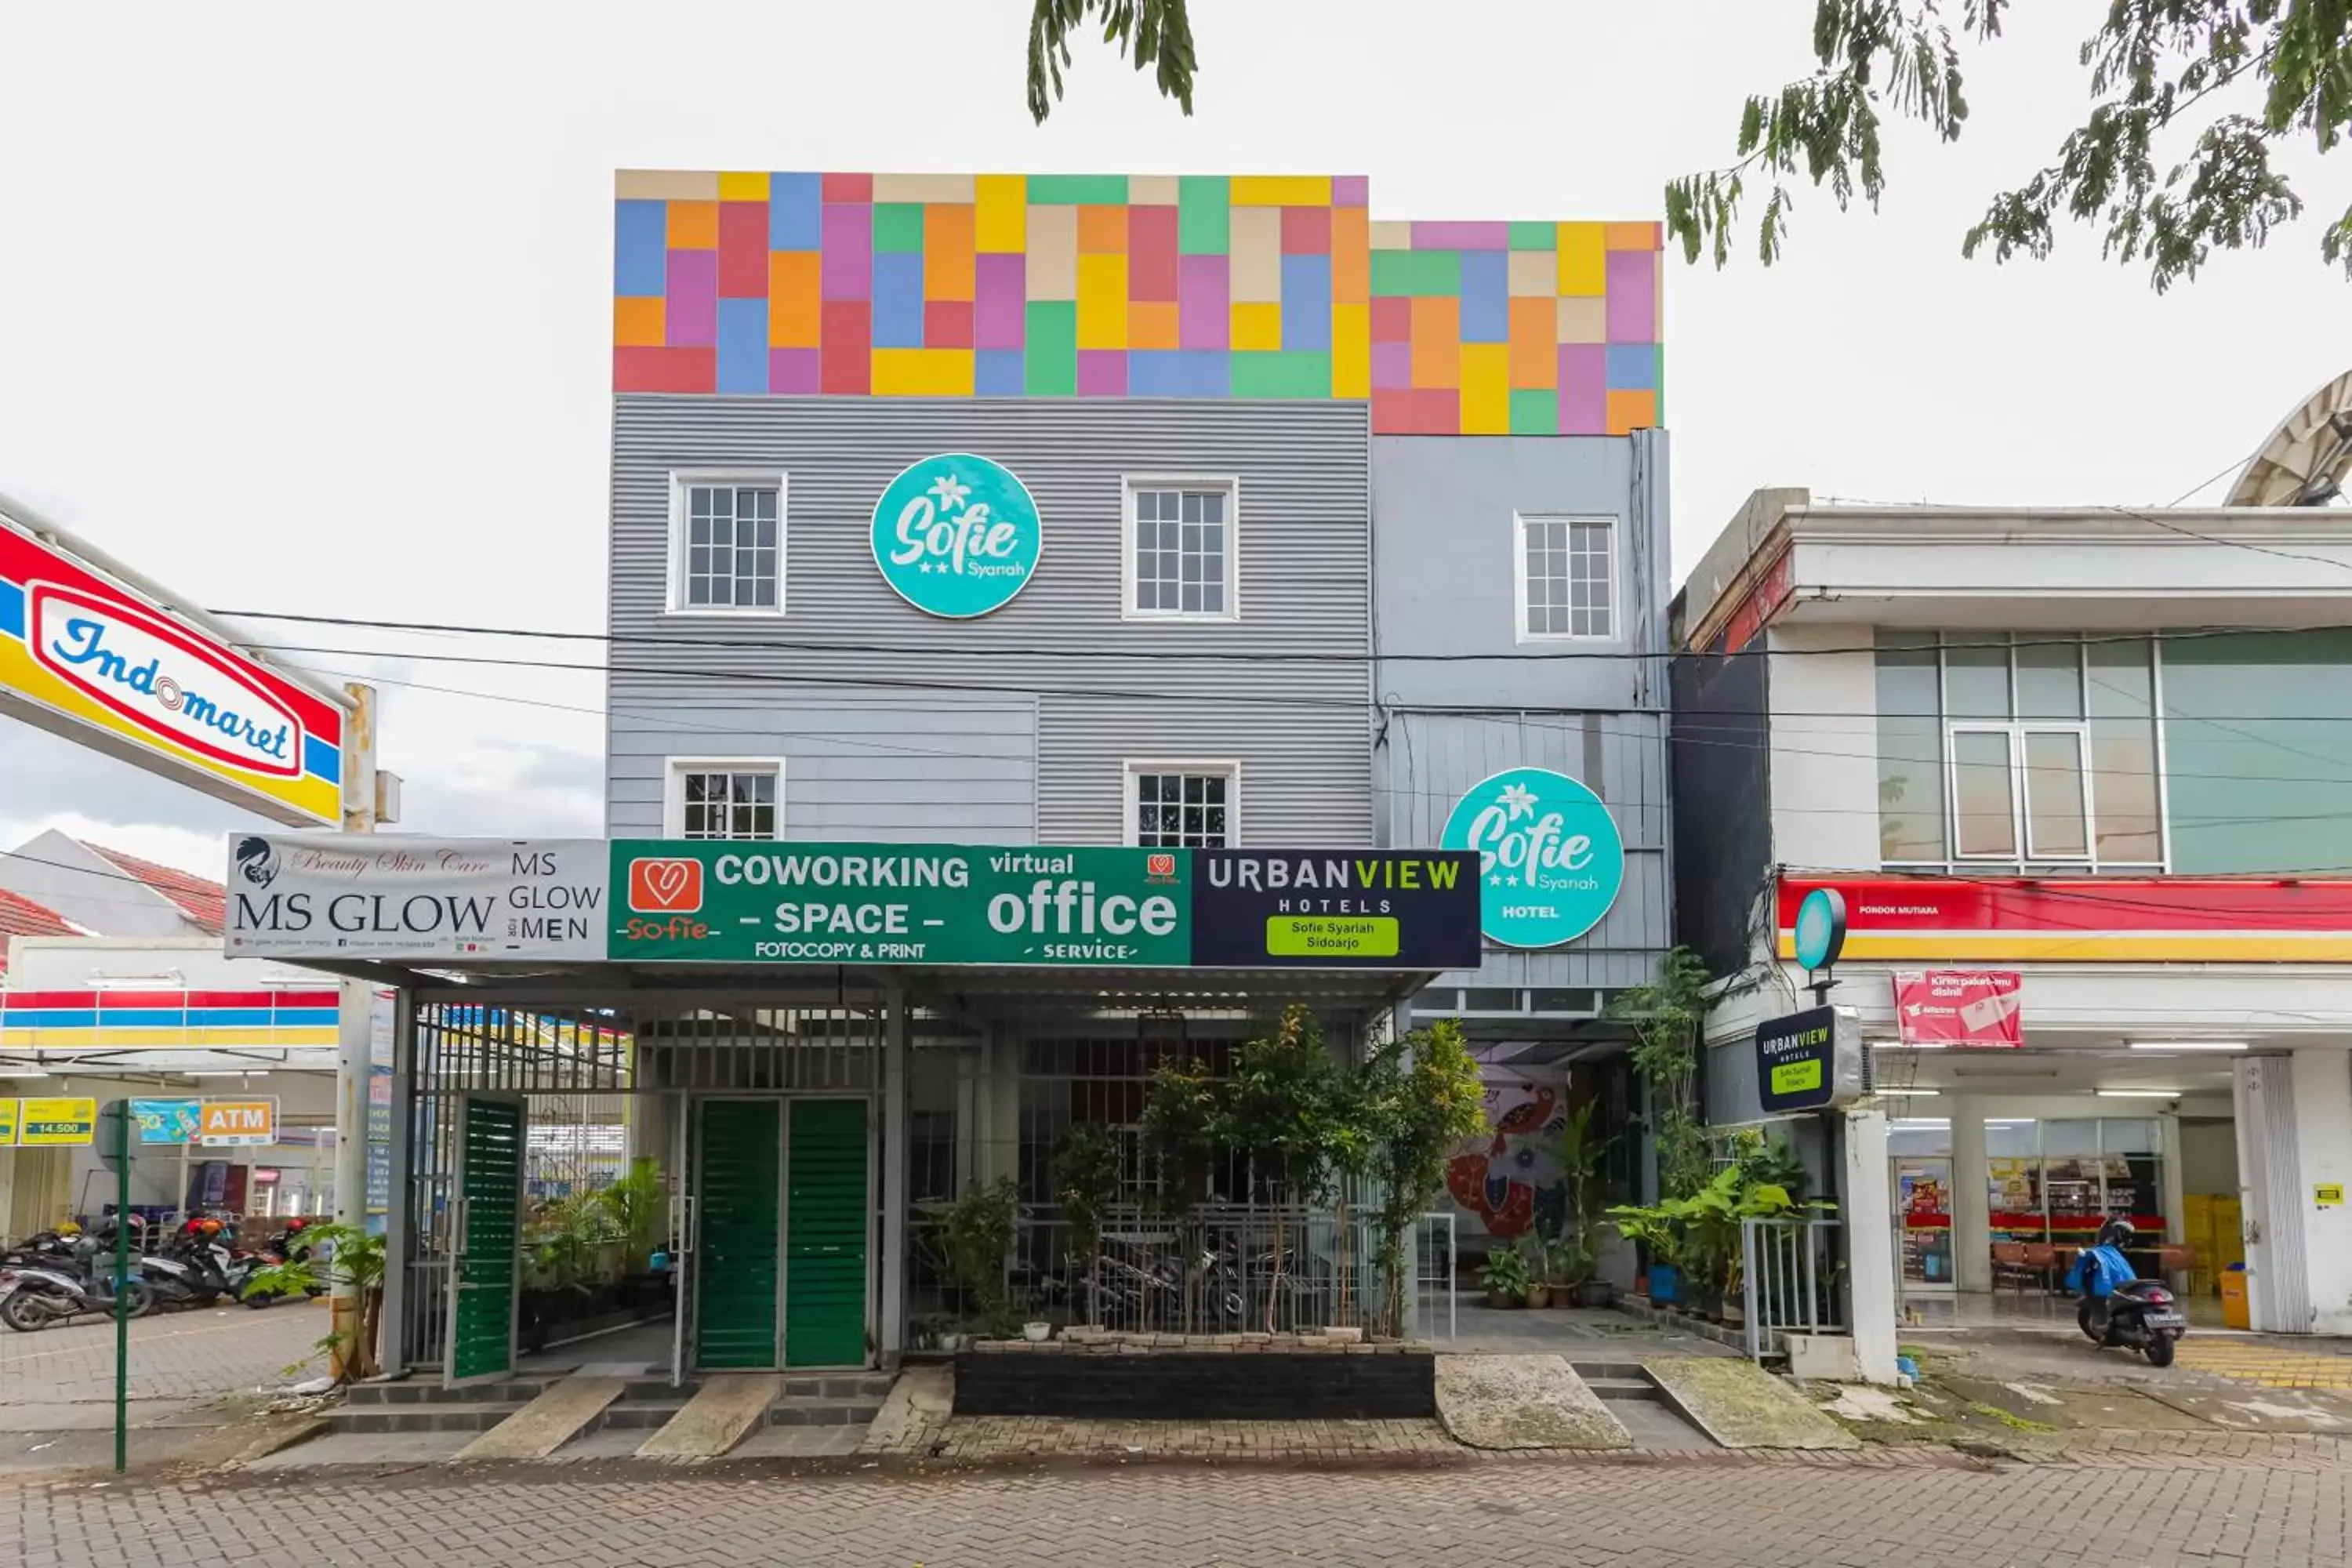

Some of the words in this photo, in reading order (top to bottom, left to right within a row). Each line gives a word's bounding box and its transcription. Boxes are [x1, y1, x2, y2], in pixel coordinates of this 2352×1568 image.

[891, 495, 1018, 575] Sofie
[967, 561, 1025, 579] Syariah
[53, 618, 287, 760] Indomaret
[1468, 806, 1594, 887] Sofie
[292, 848, 368, 879] Beauty
[376, 851, 426, 873] Skin
[436, 848, 489, 875] Care
[512, 852, 556, 876] MS
[714, 854, 969, 888] COWORKING
[989, 852, 1073, 874] virtual
[1208, 858, 1459, 892] URBANVIEW
[1539, 874, 1599, 891] Syariah
[509, 885, 601, 909] GLOW
[987, 879, 1176, 936] office
[1279, 898, 1391, 913] HOTELS
[233, 893, 312, 931] MS
[328, 894, 498, 933] GLOW
[775, 902, 909, 934] SPACE
[1502, 906, 1560, 919] HOTEL
[521, 916, 587, 939] MEN
[1291, 921, 1323, 934] Sofie
[1327, 922, 1374, 935] Syariah
[755, 942, 856, 958] FOTOCOPY
[860, 943, 873, 958] &
[878, 944, 926, 959] PRINT
[1307, 937, 1359, 950] Sidoarjo
[209, 1109, 264, 1130] ATM
